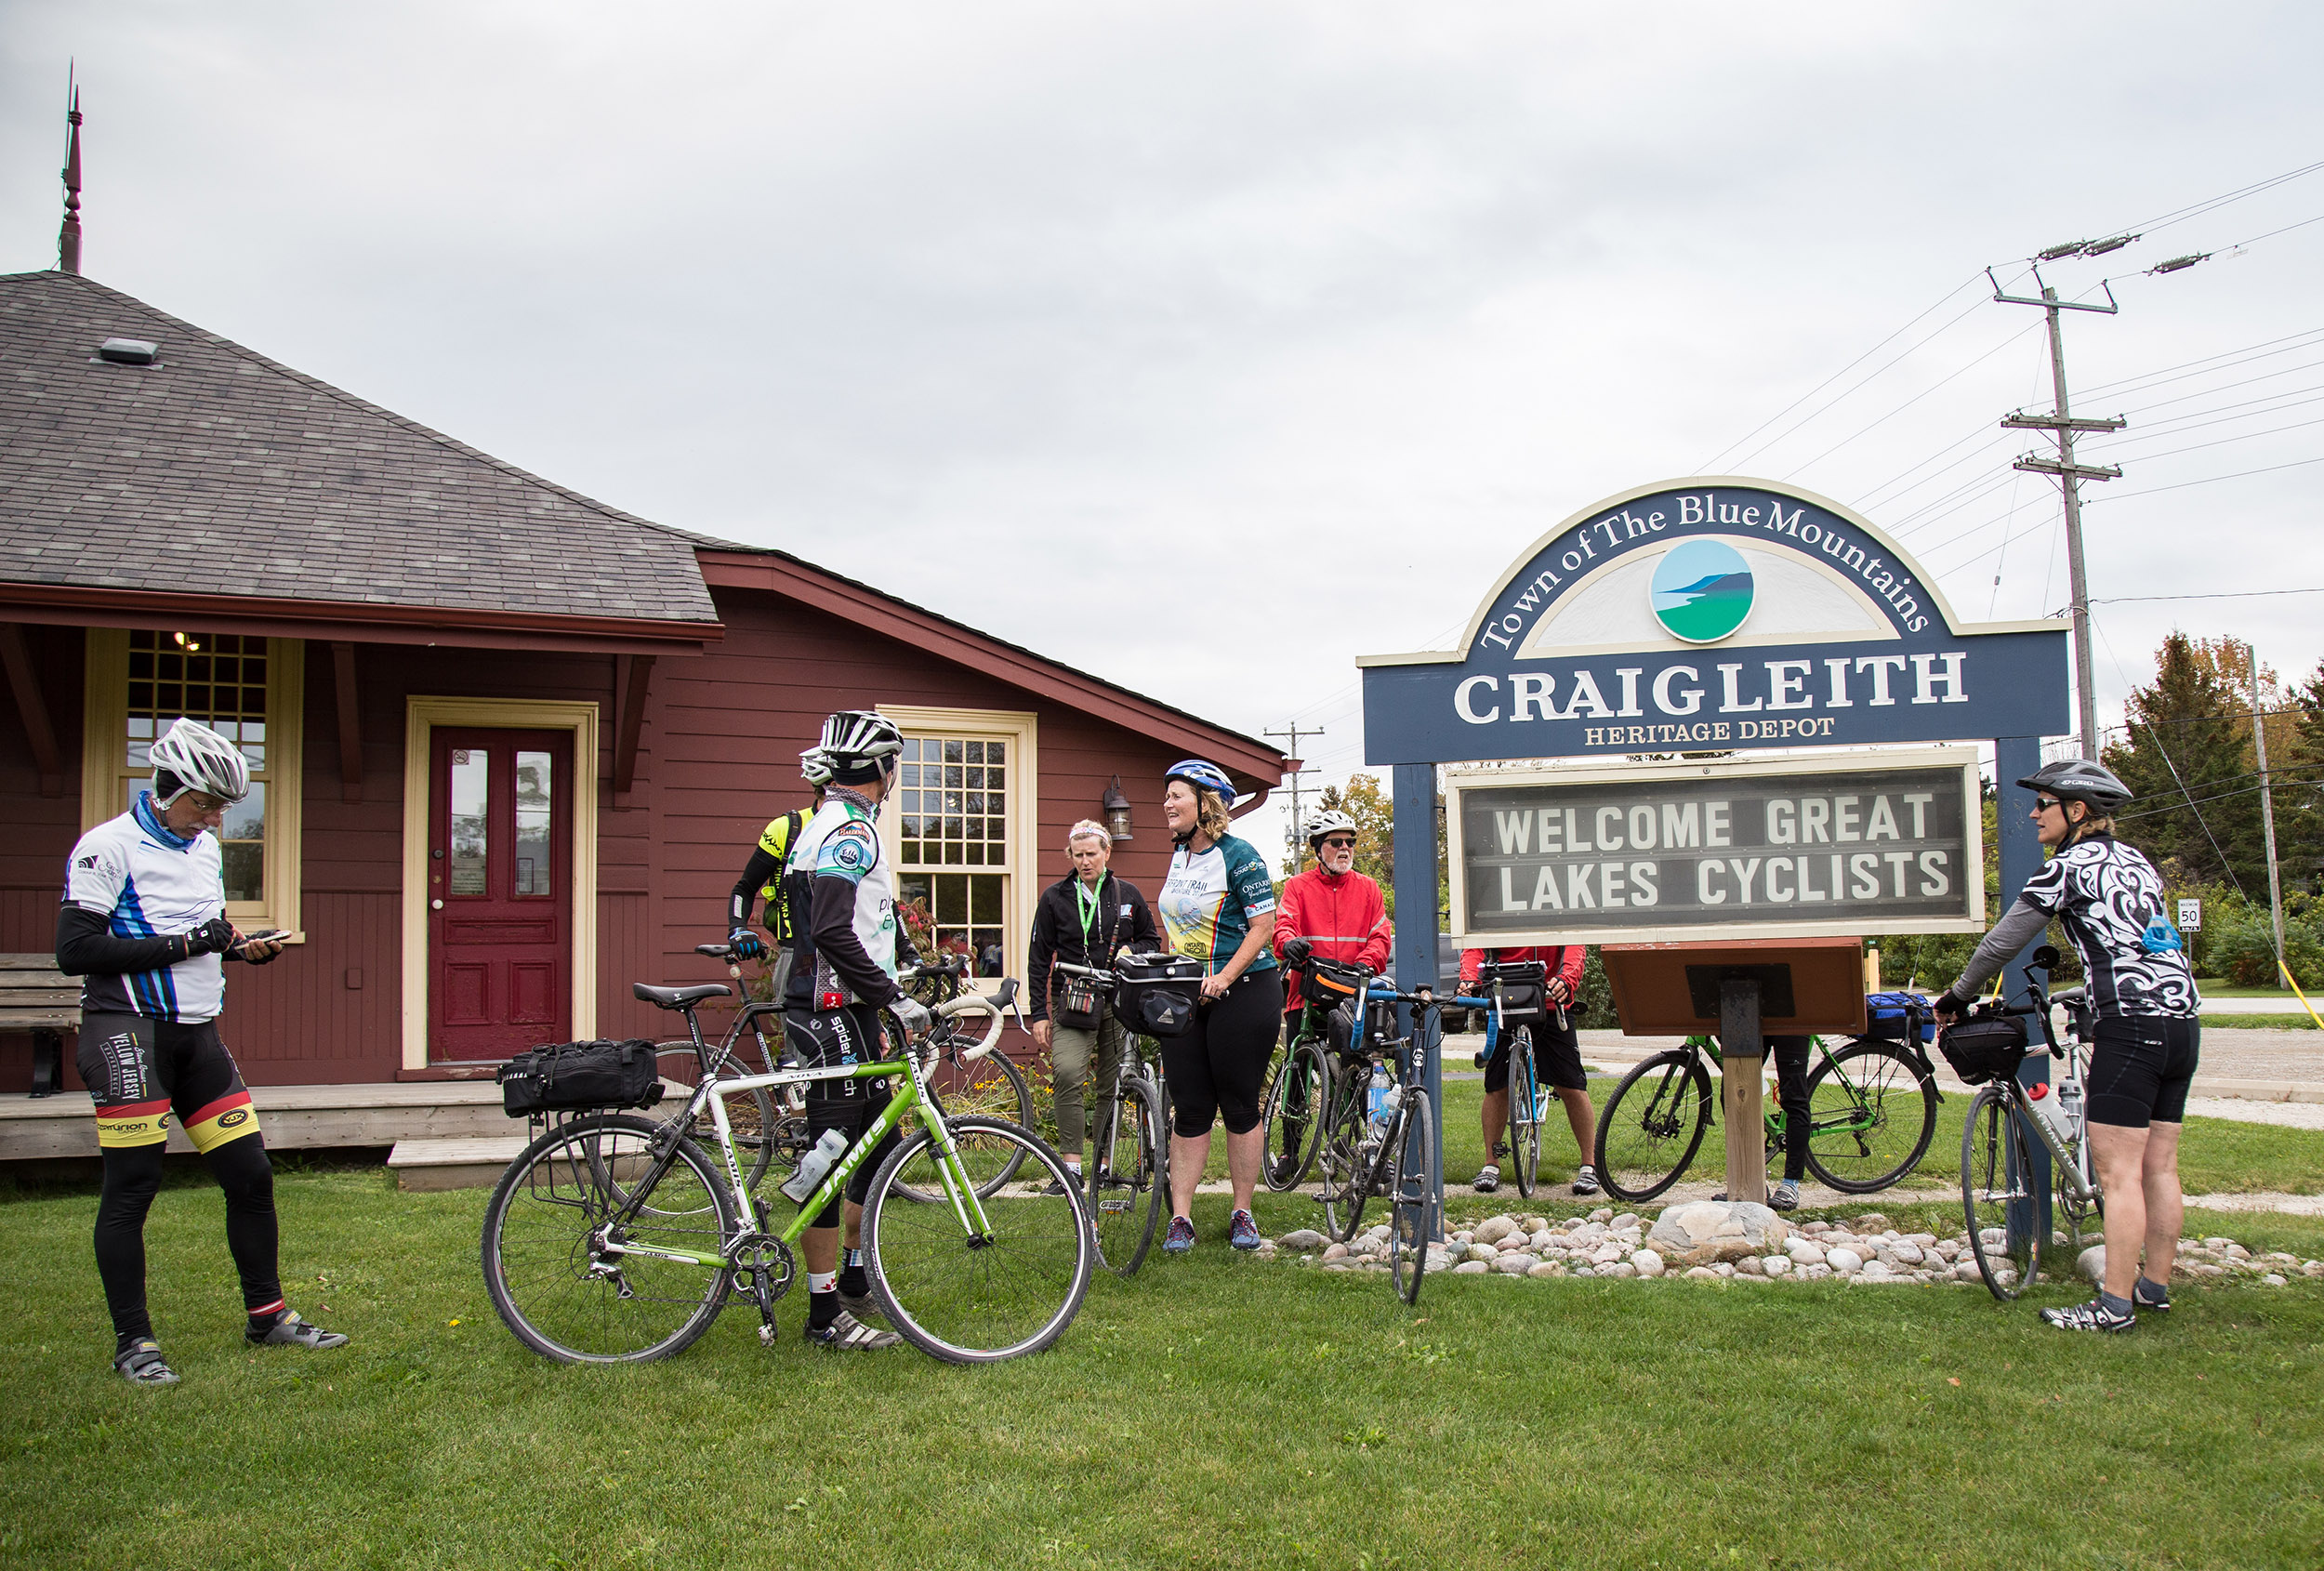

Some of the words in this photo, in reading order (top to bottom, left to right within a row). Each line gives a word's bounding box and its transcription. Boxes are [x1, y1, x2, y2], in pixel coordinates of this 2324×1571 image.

[1480, 570, 1562, 651] Town
[1562, 529, 1597, 572] of
[1593, 509, 1667, 548] The
[1676, 494, 1760, 526] Blue
[1763, 501, 1929, 633] Mountains
[1453, 652, 1969, 724] CRAIGLEITH
[1584, 721, 1731, 746] HERITAGE
[1738, 717, 1835, 740] DEPOT
[1495, 800, 1731, 854] WELCOME
[1766, 793, 1933, 844] GREAT
[1500, 861, 1658, 911] LAKES
[1697, 851, 1948, 905] CYCLISTS
[2182, 910, 2197, 921] 50
[109, 1033, 136, 1065] YELLOW
[830, 1016, 852, 1054] spider
[104, 1047, 118, 1090] EXPERIENCE
[122, 1068, 140, 1100] JERSEY
[910, 1060, 925, 1098] JAMIS
[225, 1113, 244, 1123] YJX
[723, 1141, 742, 1188] JAMIS
[822, 1115, 887, 1202] JAMIS
